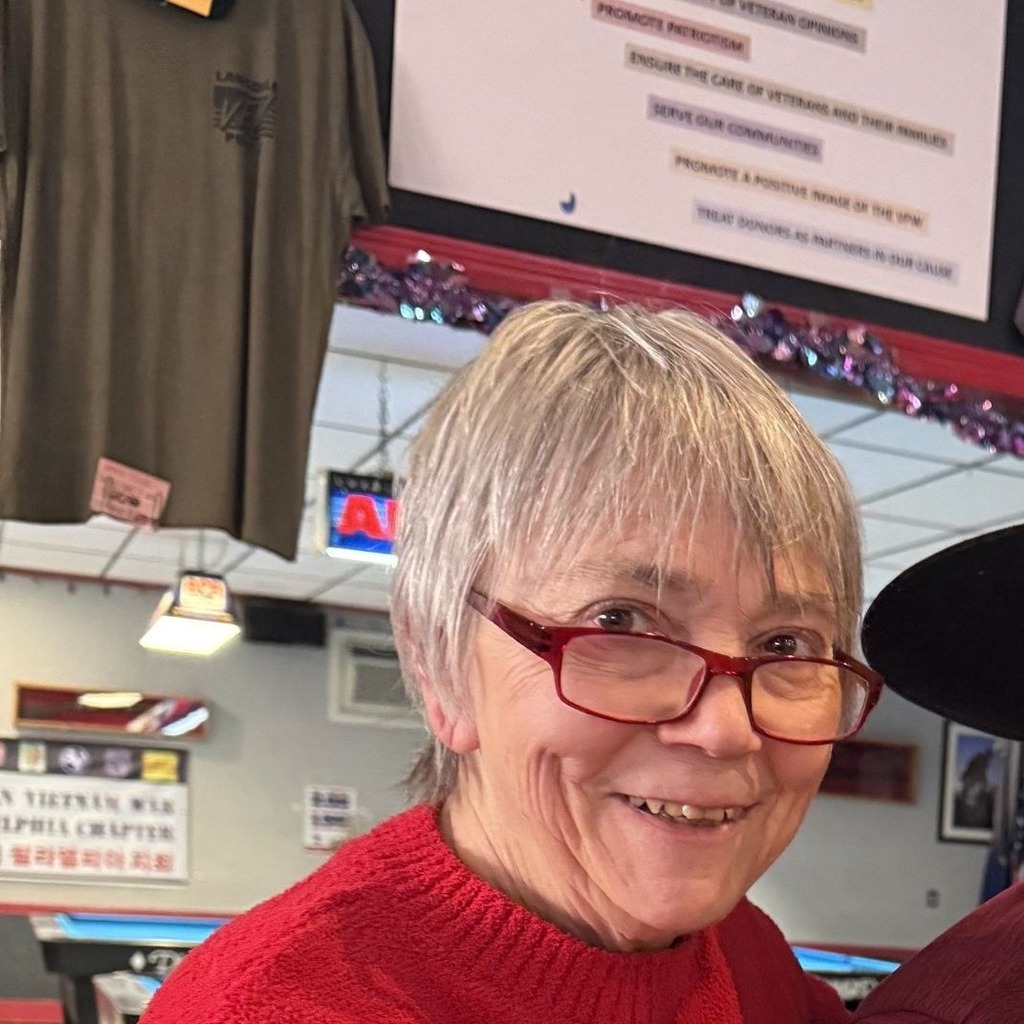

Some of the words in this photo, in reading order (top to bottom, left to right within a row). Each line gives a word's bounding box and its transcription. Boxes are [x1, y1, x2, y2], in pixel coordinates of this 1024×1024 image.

[597, 3, 664, 31] PROMOTE
[667, 20, 744, 51] PATRIOTISM
[798, 17, 859, 44] OPINIONS
[630, 51, 681, 76] ENSURE
[684, 66, 709, 84] THE
[711, 74, 744, 92] CARE
[747, 84, 764, 97] OF
[766, 88, 830, 117] VETERANS
[832, 107, 860, 124] AND
[861, 115, 895, 133] THEIR
[897, 125, 949, 149] FAMILIES
[653, 103, 693, 123] SERVE
[695, 114, 725, 131] OUR
[726, 123, 819, 156] COMMUNITIES
[675, 155, 738, 181] PROMOTE
[743, 171, 751, 184] A
[754, 175, 807, 200] POSITIVE
[811, 190, 850, 212] IMAGE
[852, 202, 870, 214] OF
[873, 205, 894, 222] THE
[697, 206, 735, 226] TREAT
[738, 216, 791, 240] DONORS
[795, 230, 810, 244] AS
[812, 233, 871, 259] PARTNERS
[889, 254, 914, 269] OUR
[915, 258, 952, 281] CAUSE
[76, 822, 175, 843] CHAPTER
